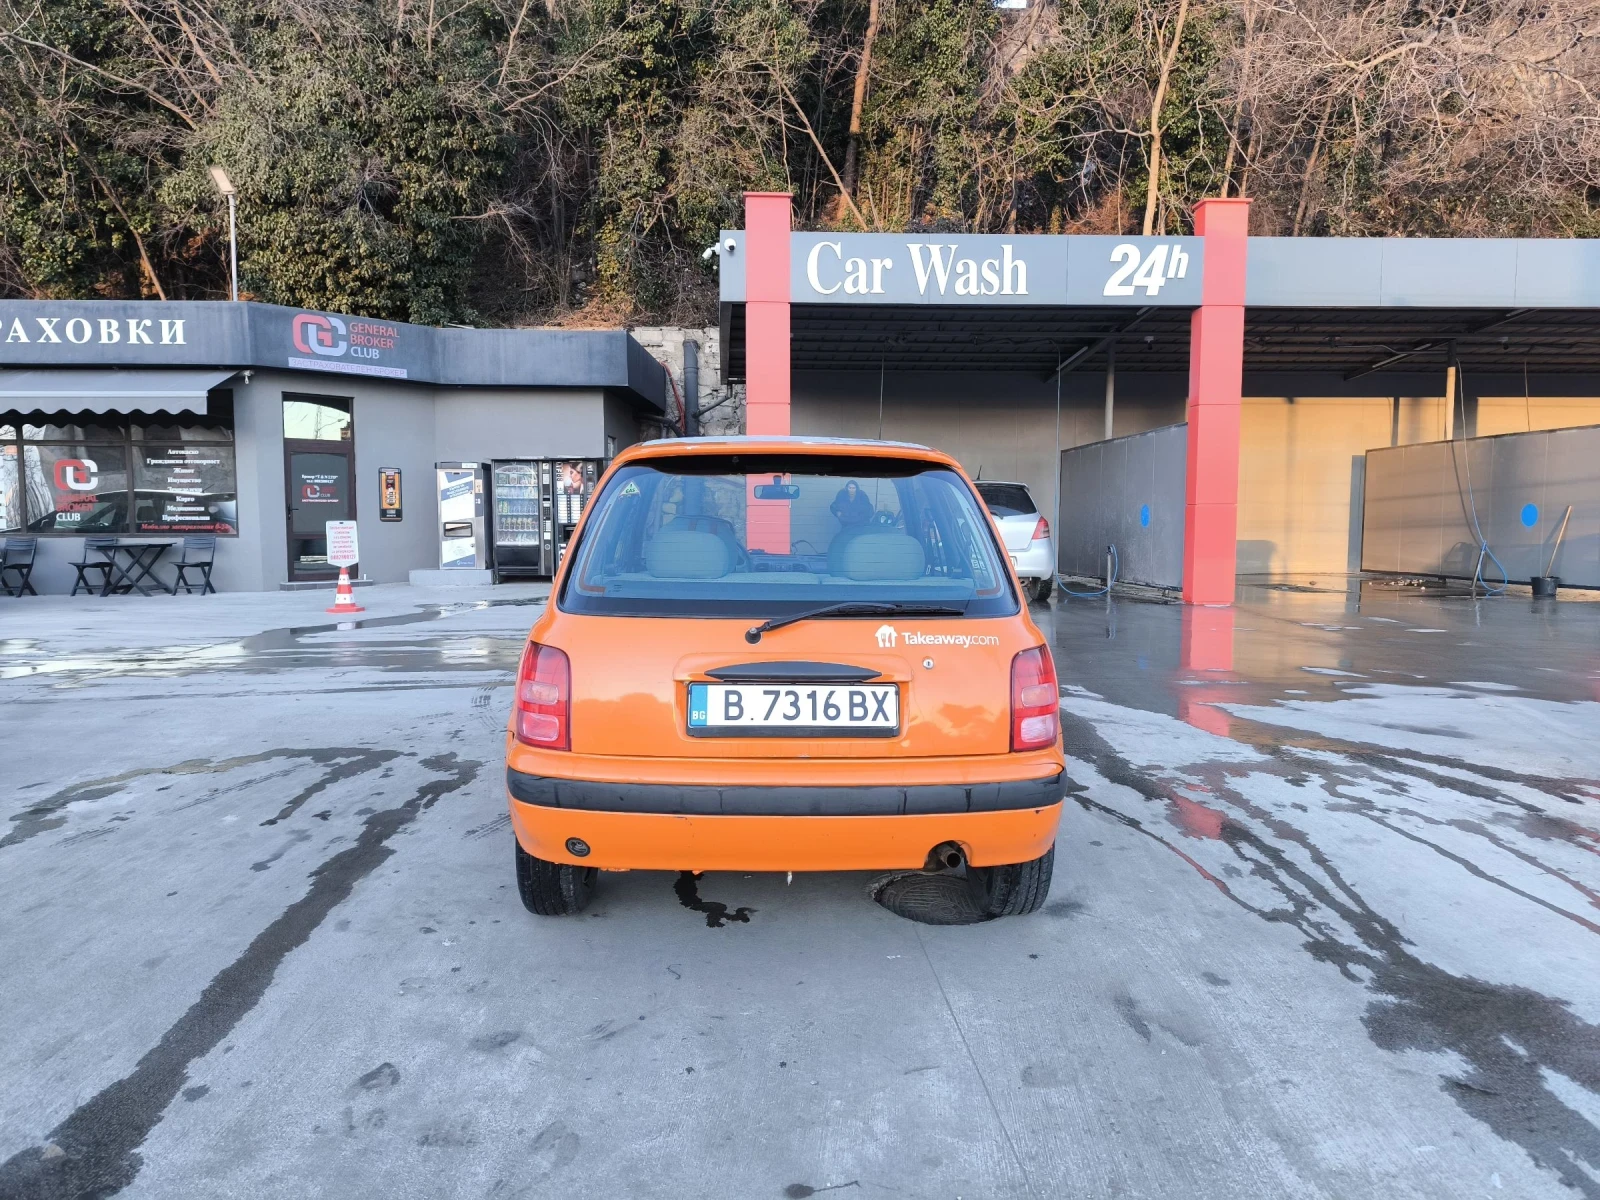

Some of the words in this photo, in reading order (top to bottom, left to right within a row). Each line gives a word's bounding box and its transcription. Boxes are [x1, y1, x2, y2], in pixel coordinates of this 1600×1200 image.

[806, 240, 892, 296] Car
[906, 242, 1028, 297] Wash
[1103, 243, 1189, 297] 24h
[0, 316, 187, 345] АХОВКИ
[349, 322, 400, 338] GENERAL
[350, 335, 394, 349] BROKER
[350, 346, 380, 359] CLUB
[374, 367, 405, 377] БРОКЕР
[56, 512, 81, 521] CLUB
[901, 631, 1000, 648] Takeaway.com
[691, 710, 706, 720] BG
